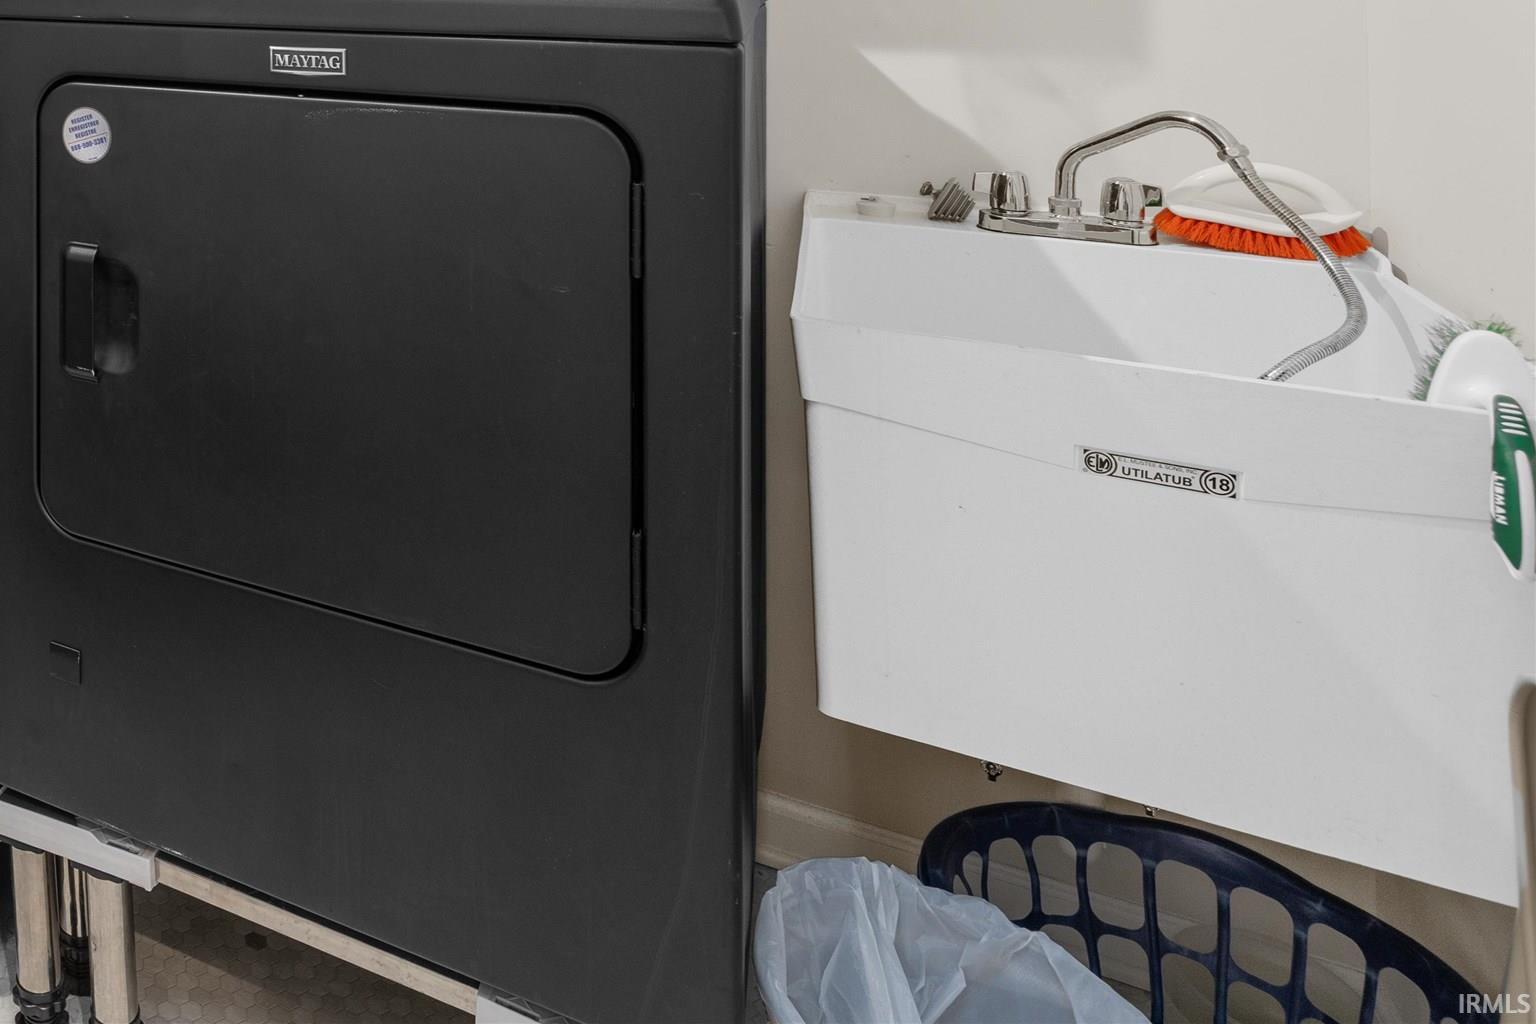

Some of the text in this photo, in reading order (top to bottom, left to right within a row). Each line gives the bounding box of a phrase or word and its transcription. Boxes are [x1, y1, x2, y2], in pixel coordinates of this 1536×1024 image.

[274, 53, 341, 69] MAYTAG
[1122, 466, 1230, 492] UTILATUB 18
